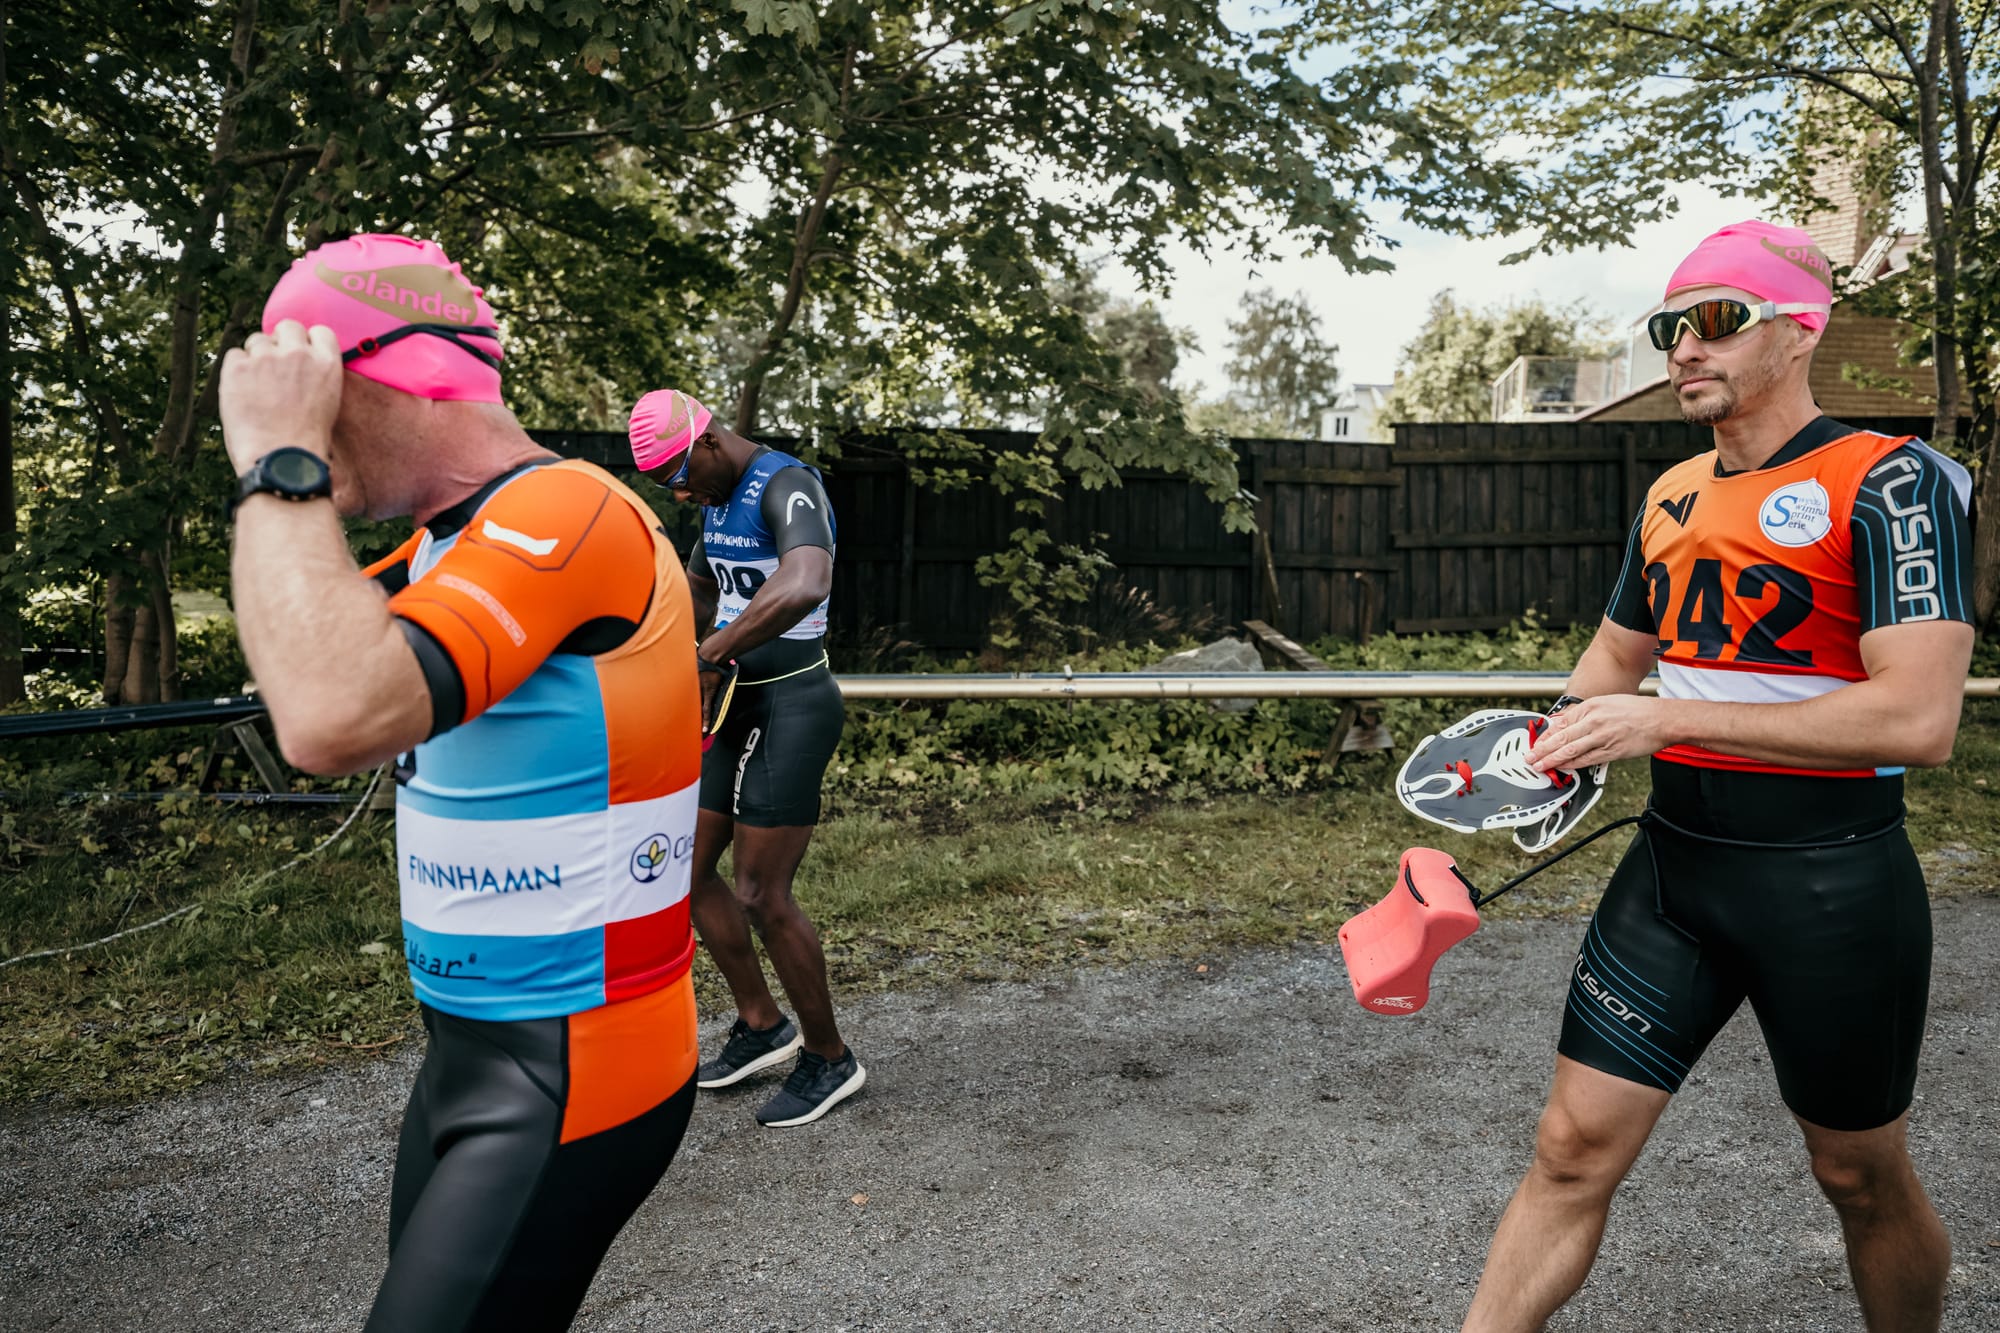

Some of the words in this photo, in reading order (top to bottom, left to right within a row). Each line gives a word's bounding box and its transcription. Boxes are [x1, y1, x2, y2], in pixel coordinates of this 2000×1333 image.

[341, 271, 472, 324] olander
[733, 727, 761, 815] HEAD
[409, 854, 562, 893] FINNHAMN
